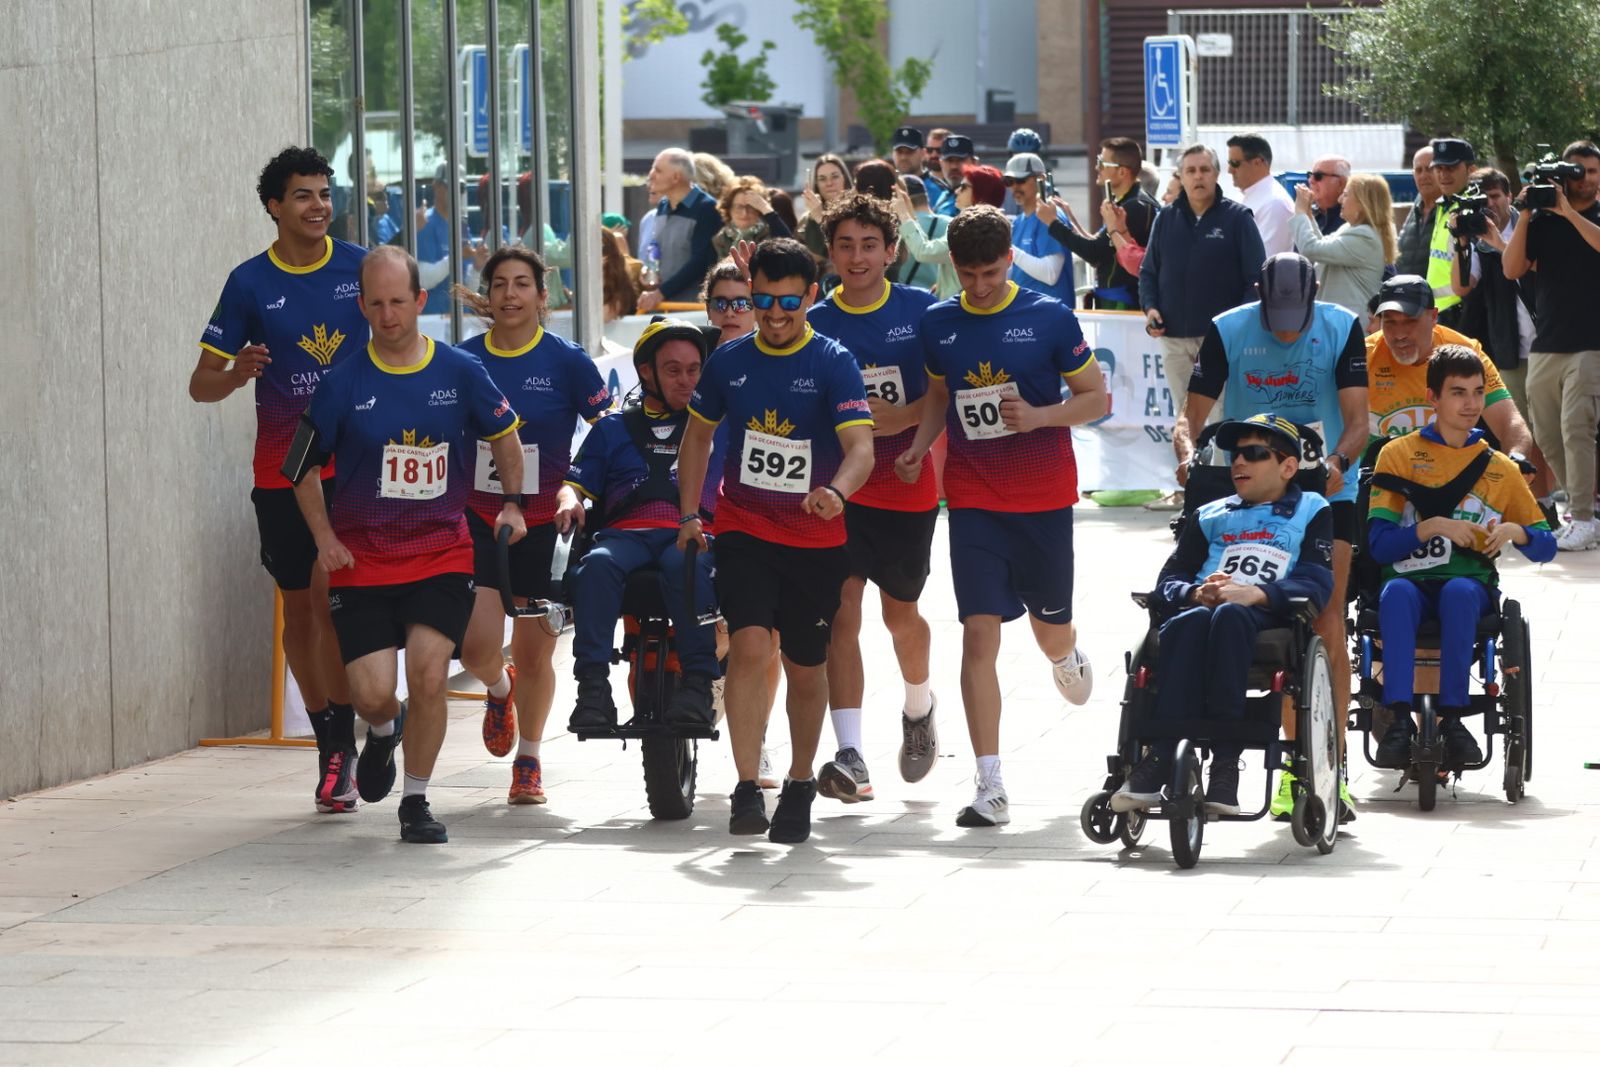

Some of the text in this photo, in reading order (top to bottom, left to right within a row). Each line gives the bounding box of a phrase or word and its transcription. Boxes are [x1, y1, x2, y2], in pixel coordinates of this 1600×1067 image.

[886, 324, 913, 337] ADAS
[1004, 328, 1034, 337] ADAS
[291, 371, 321, 386] CAJA
[525, 377, 551, 386] ADAS
[293, 387, 305, 396] DE
[430, 389, 457, 399] ADAS
[964, 400, 1002, 428] 50
[386, 455, 446, 485] 1810
[747, 447, 807, 480] 592
[1223, 555, 1279, 583] 565
